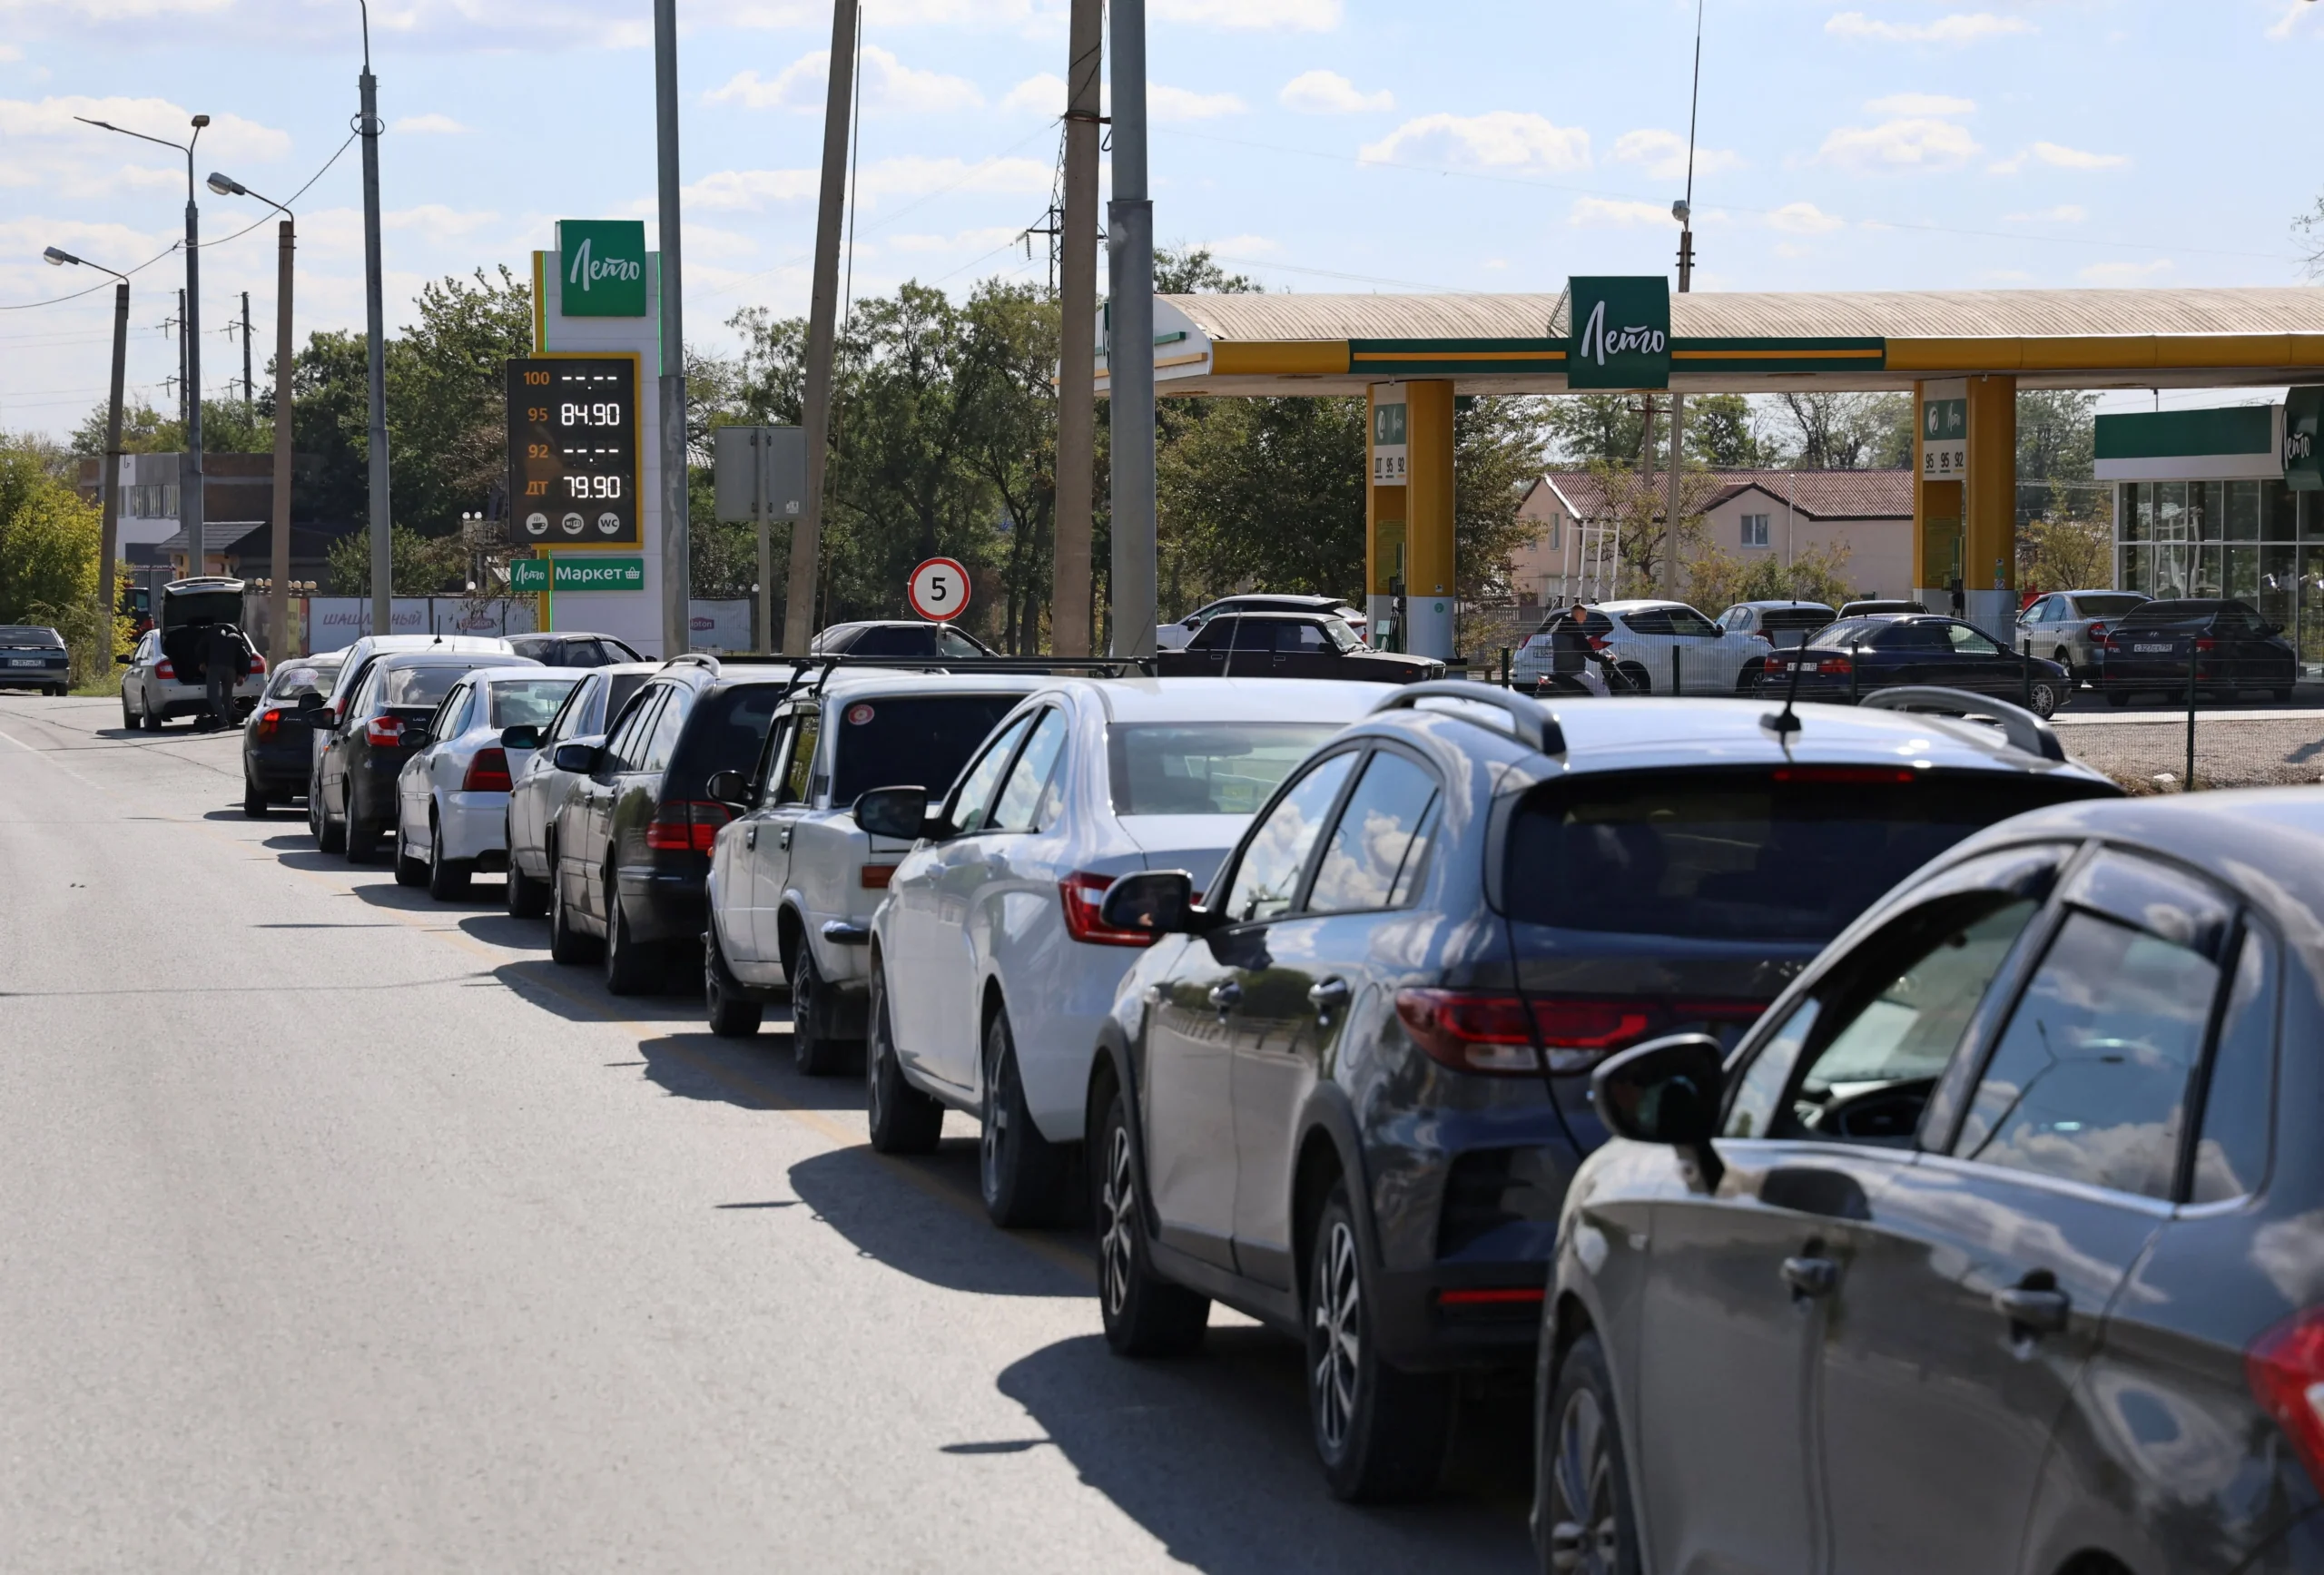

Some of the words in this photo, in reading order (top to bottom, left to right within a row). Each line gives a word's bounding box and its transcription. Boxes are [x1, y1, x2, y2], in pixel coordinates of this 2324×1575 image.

[570, 238, 640, 291] Лето
[1581, 300, 1665, 366] Лето
[524, 371, 550, 385] 100
[527, 408, 548, 421] 95
[561, 403, 620, 426] 84.90
[528, 444, 548, 458] 92
[1925, 453, 1934, 468] 95
[1941, 452, 1949, 468] 95
[1955, 451, 1964, 467] 92
[1386, 458, 1393, 473] 95
[1398, 457, 1405, 472] 92
[525, 481, 549, 496] ДТ
[563, 476, 620, 498] 79.90
[600, 519, 618, 527] WC
[516, 563, 545, 585] Лето
[556, 566, 623, 583] Маркет
[931, 576, 947, 601] 5
[323, 611, 422, 625] ШАШЛНЫЙ
[690, 619, 712, 628] ipton
